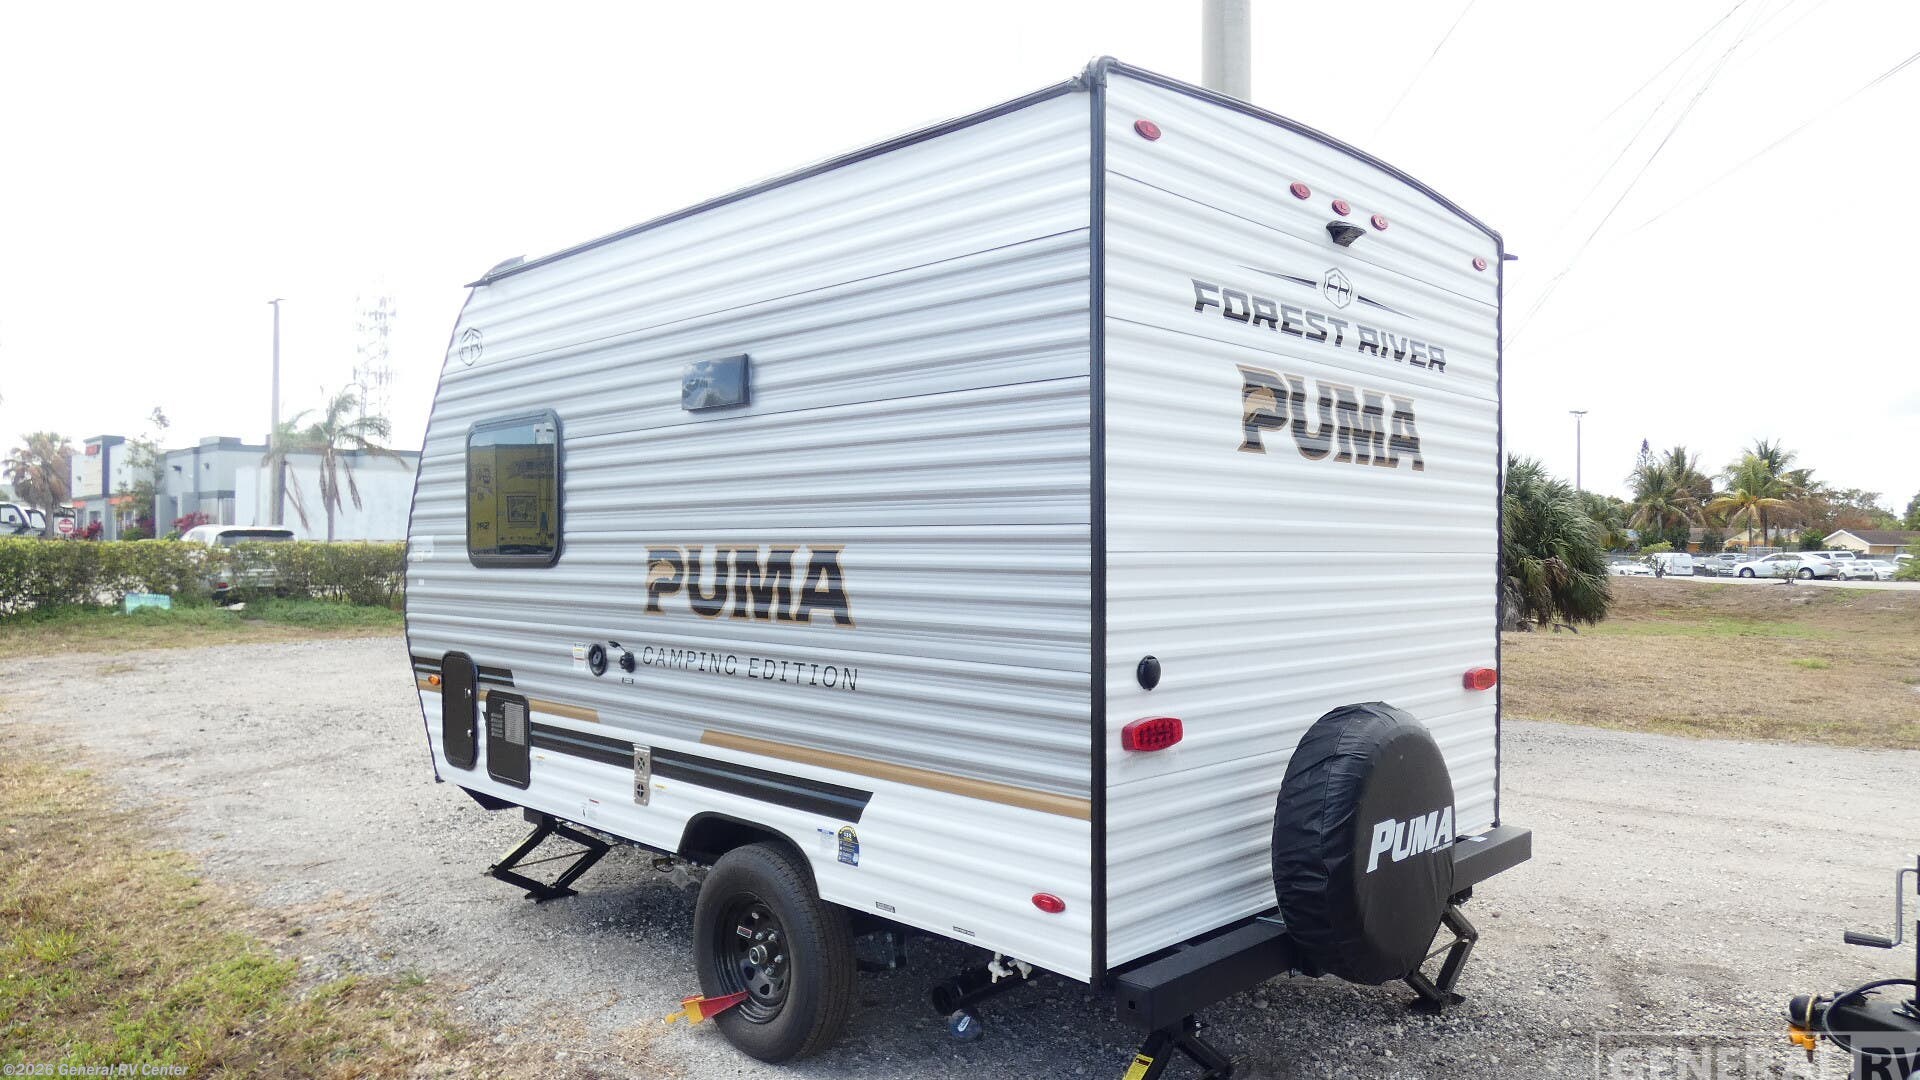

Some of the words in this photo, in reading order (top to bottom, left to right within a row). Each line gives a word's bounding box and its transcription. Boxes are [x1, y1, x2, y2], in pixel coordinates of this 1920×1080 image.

[1191, 279, 1348, 347] FOREST
[1356, 324, 1447, 373] RIVER
[1236, 364, 1425, 472] PUMA
[645, 545, 856, 628] PUMA
[642, 646, 738, 676] CAMPING
[748, 657, 858, 691] EDITION
[1366, 805, 1452, 873] PUMA
